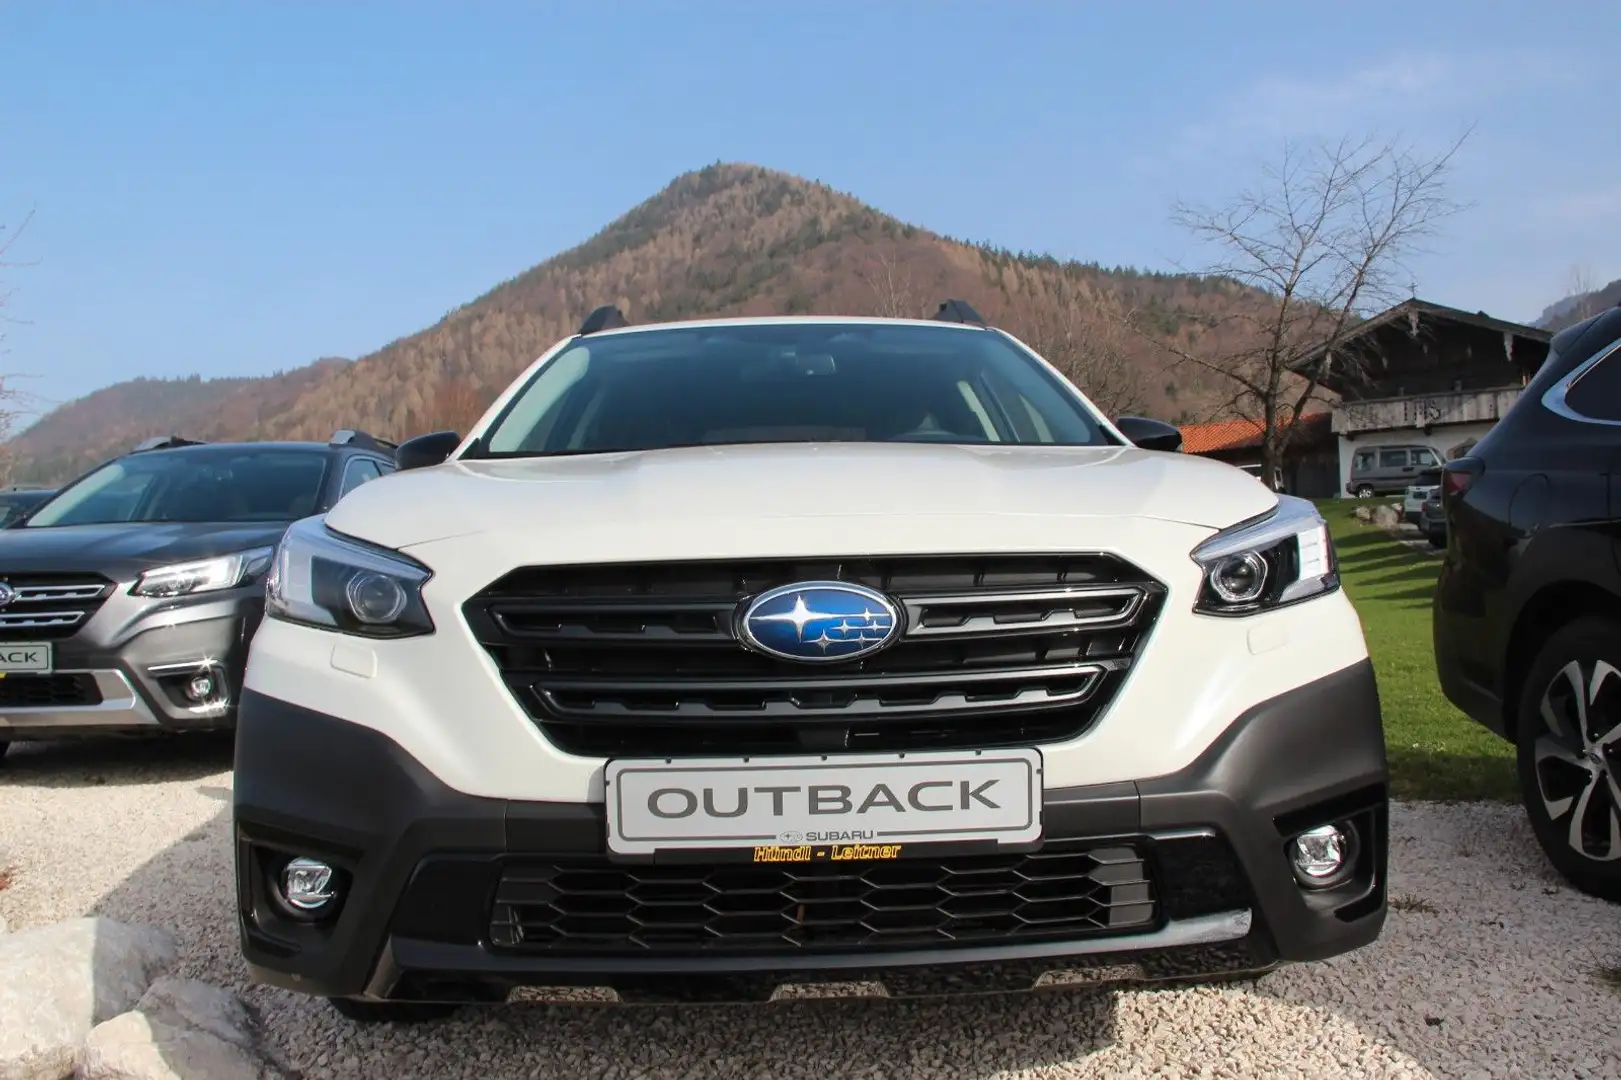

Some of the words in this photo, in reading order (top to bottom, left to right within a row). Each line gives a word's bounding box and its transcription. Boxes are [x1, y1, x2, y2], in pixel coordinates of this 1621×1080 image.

[647, 779, 1001, 819] OUTBACK
[806, 830, 874, 842] SUBARU
[831, 843, 902, 861] Leitner
